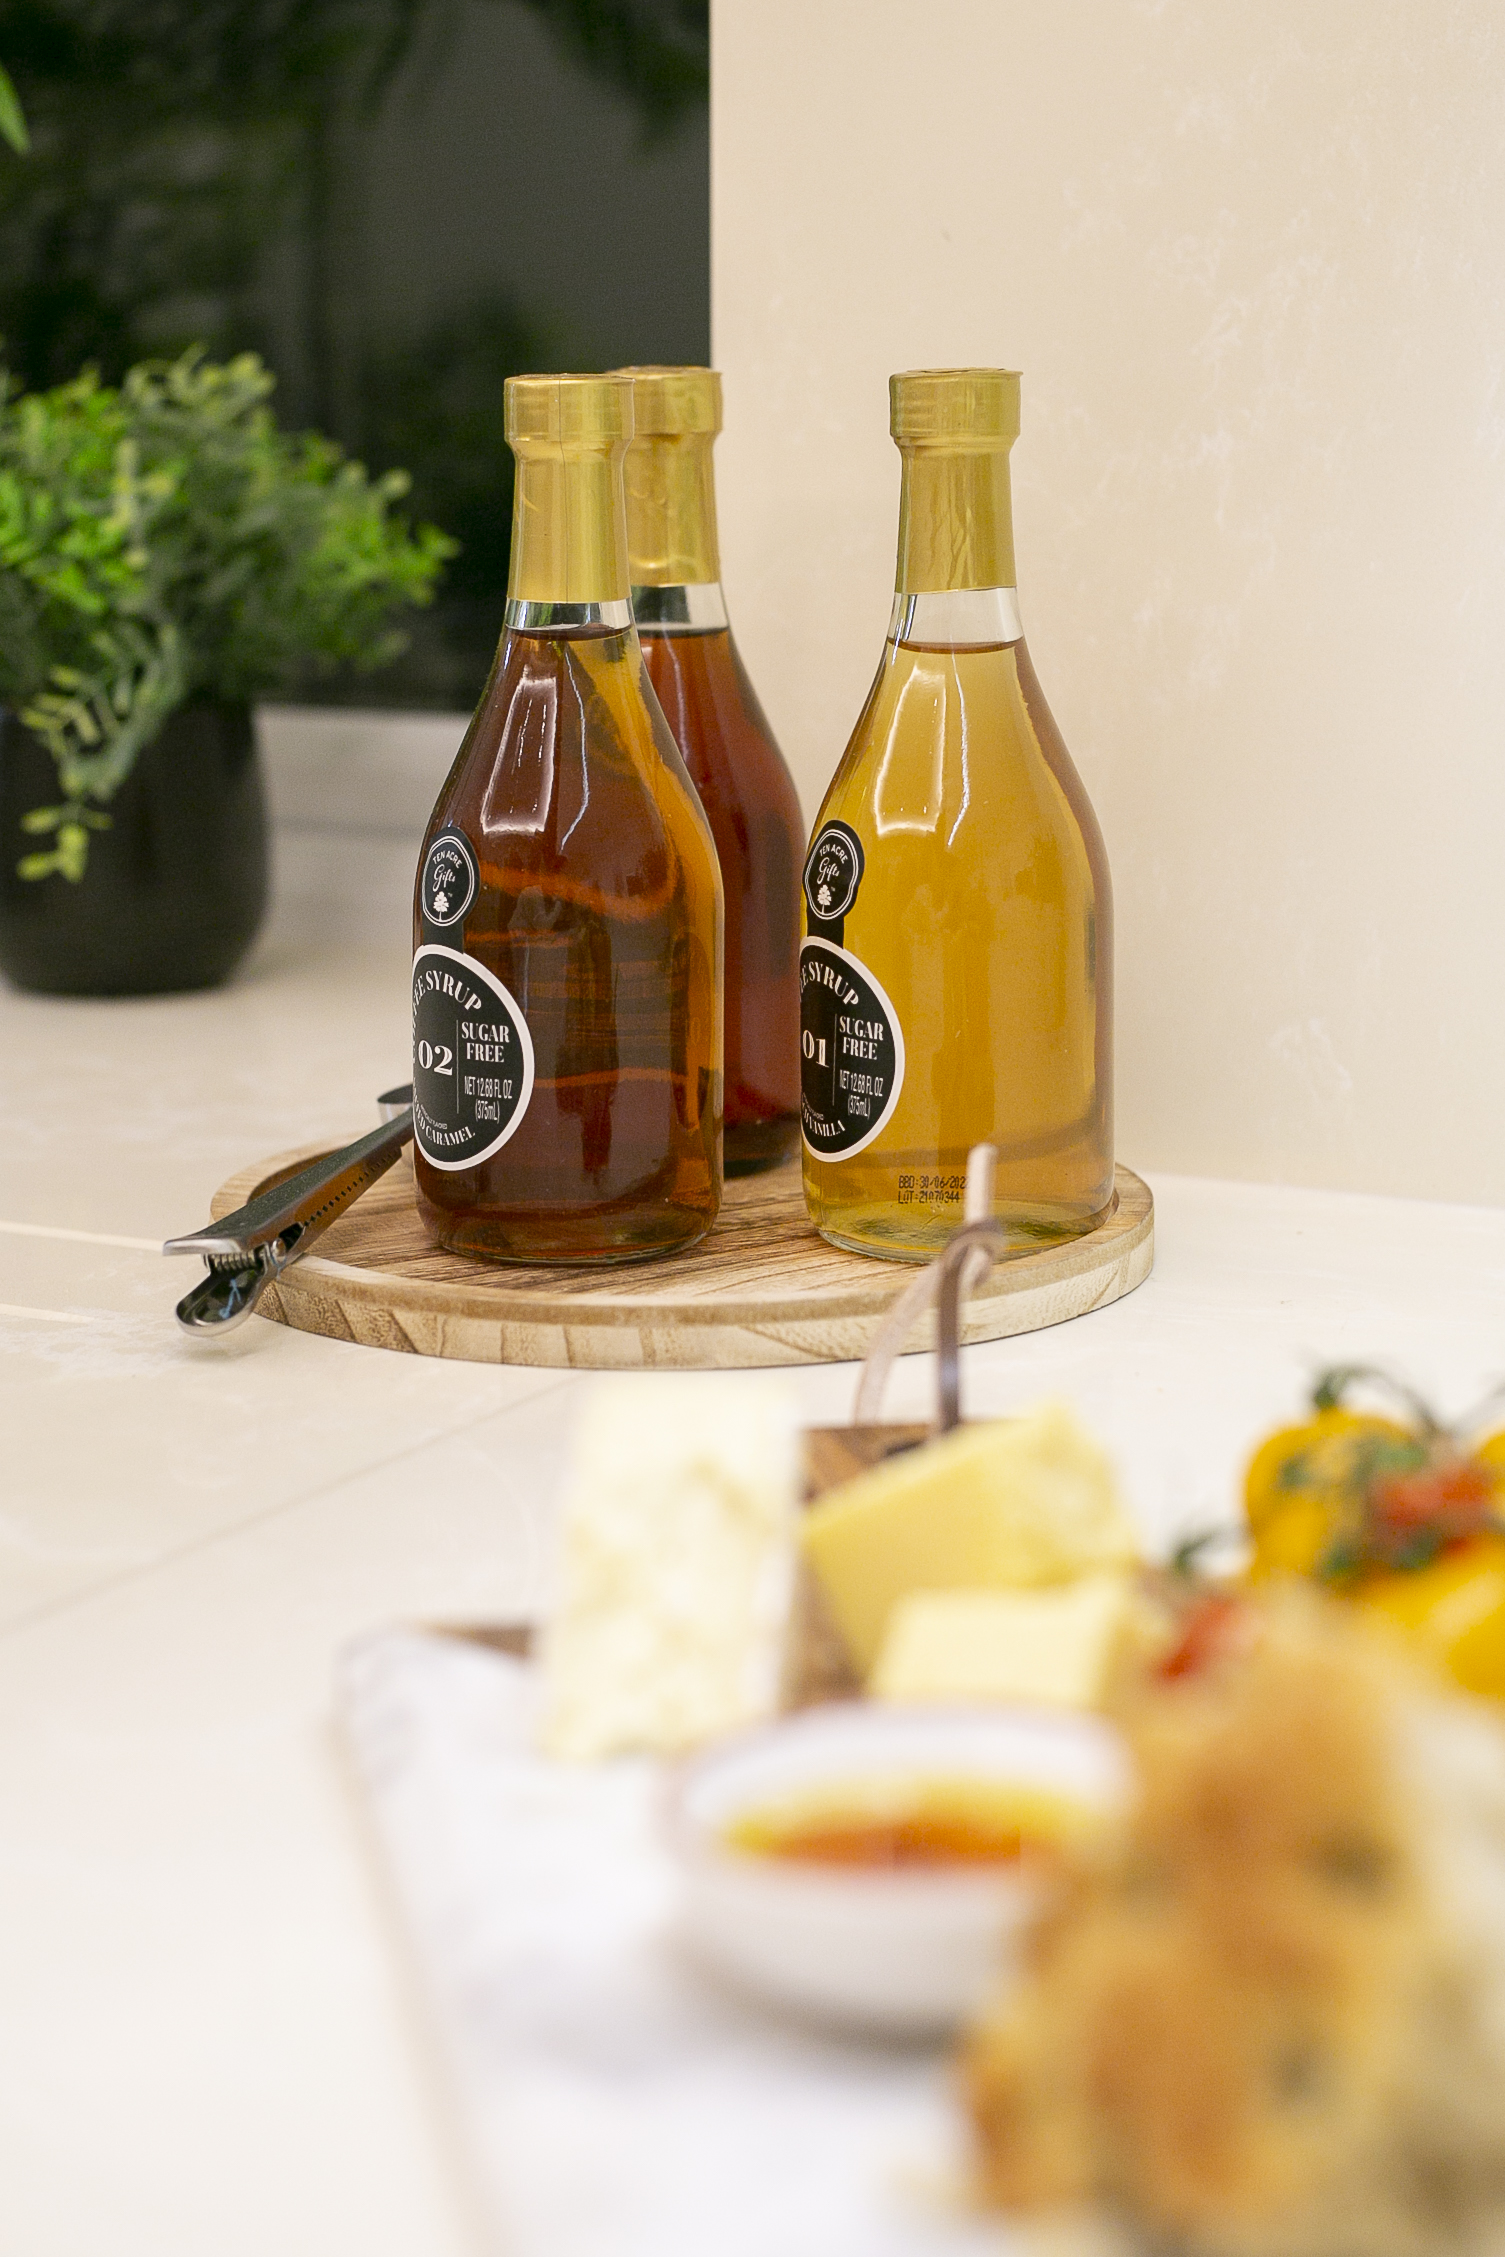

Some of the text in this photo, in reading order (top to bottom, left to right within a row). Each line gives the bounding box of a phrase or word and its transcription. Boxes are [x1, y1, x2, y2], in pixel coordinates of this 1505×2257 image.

[433, 850, 463, 868] TEN ACRE
[819, 844, 848, 864] TEN ACRE
[432, 863, 456, 892] Gifts
[816, 856, 840, 885] Gifts
[425, 970, 482, 1011] SYRUP
[808, 961, 859, 1005] SYRUP
[461, 1021, 510, 1043] SUGAR
[839, 1015, 884, 1041] SUGAR
[418, 1039, 453, 1076] 02
[466, 1042, 505, 1063] FREE
[802, 1029, 829, 1069] 01
[842, 1036, 878, 1060] FREE
[464, 1075, 476, 1096] NET
[494, 1078, 502, 1099] FL
[503, 1079, 513, 1099] OZ
[839, 1069, 850, 1090] NET
[865, 1075, 873, 1096] FL
[874, 1076, 884, 1097] OZ
[475, 1098, 500, 1124] (375mL)
[847, 1093, 871, 1120] (375mL)
[425, 1125, 476, 1146] CARAMEL
